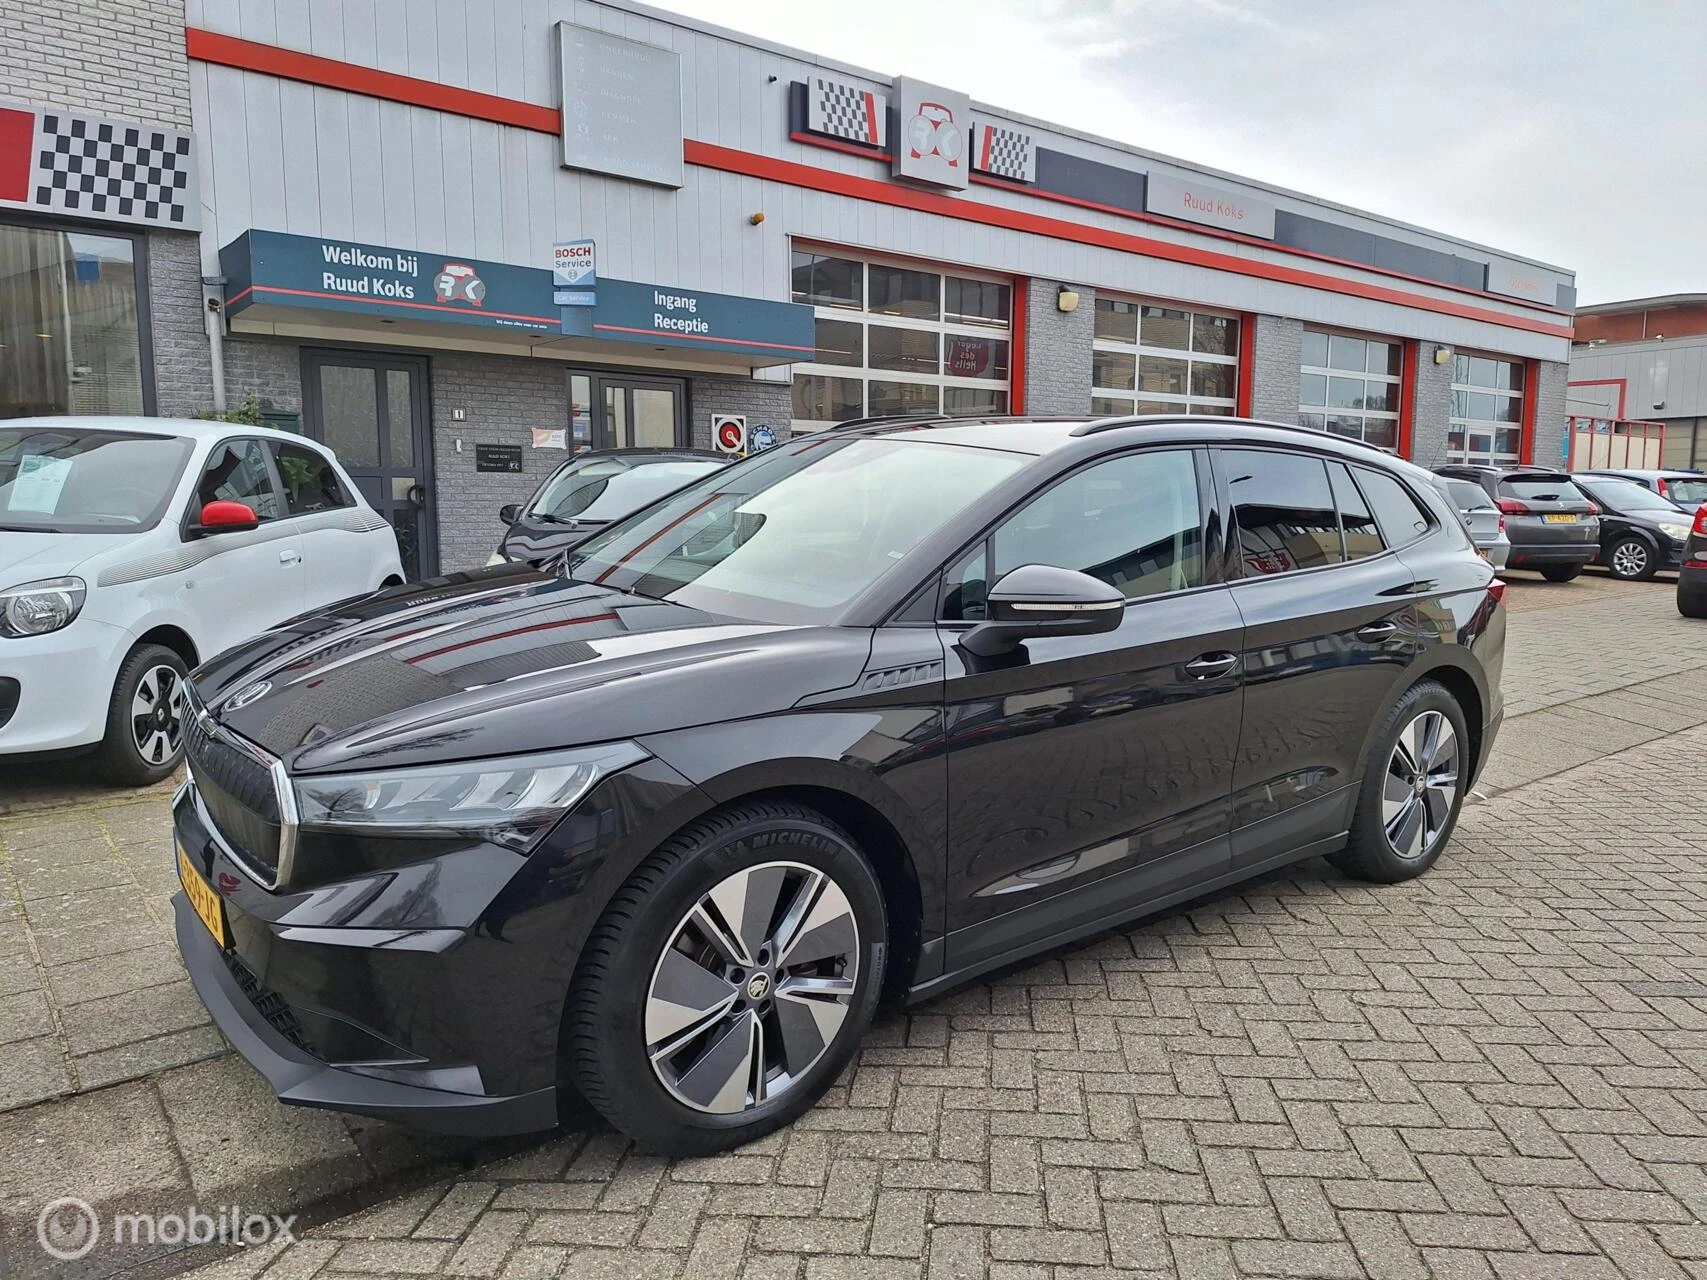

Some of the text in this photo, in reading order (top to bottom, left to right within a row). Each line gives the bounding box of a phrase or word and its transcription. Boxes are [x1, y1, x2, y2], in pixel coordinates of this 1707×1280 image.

[1184, 192, 1244, 220] Ruud Koks
[321, 244, 418, 278] Welkom bij
[555, 247, 592, 259] BOSCH
[555, 258, 592, 268] Service
[322, 272, 415, 299] Ruud Koks
[654, 290, 697, 313] Ingang
[654, 313, 709, 334] Receptie
[752, 831, 839, 856] MICHELIN
